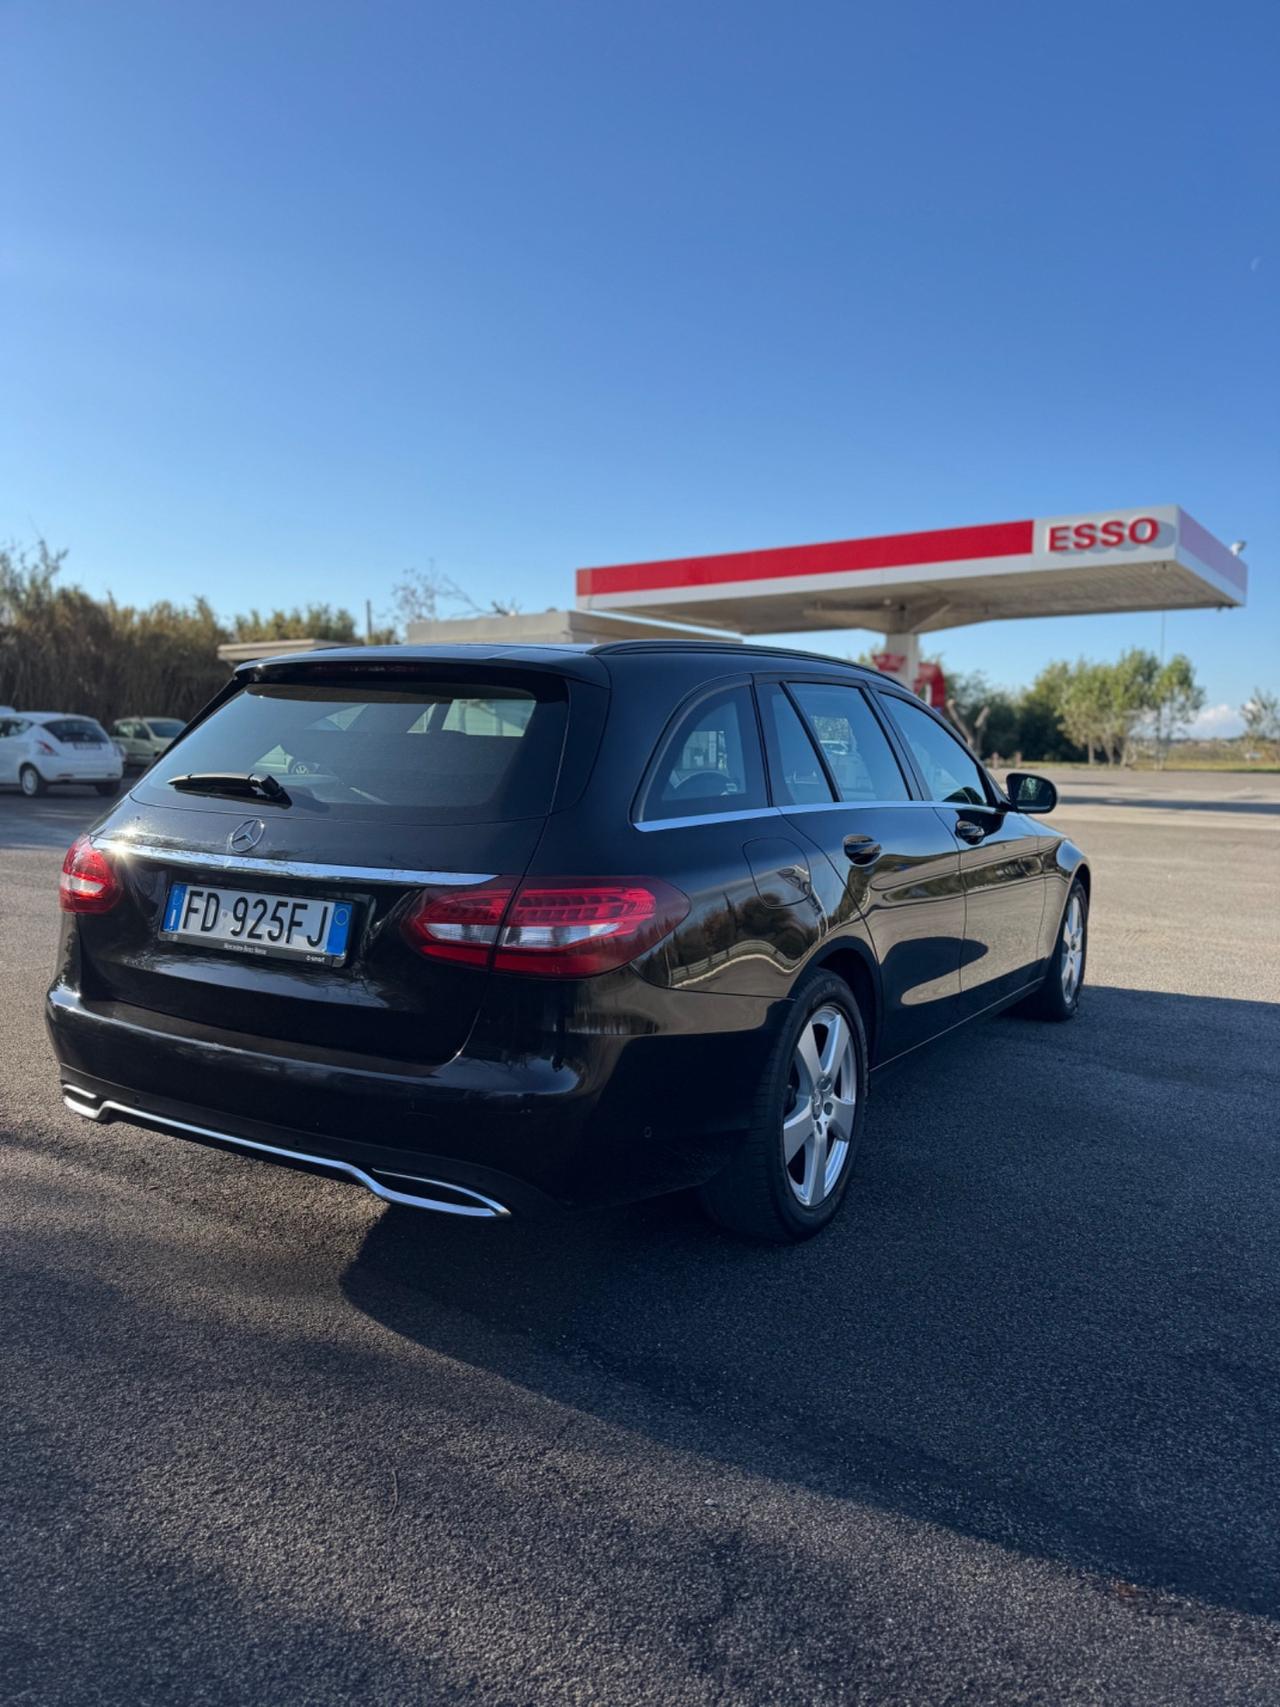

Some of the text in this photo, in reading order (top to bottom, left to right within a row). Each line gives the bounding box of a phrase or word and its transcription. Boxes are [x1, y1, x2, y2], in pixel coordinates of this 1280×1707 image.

[1048, 517, 1159, 552] ESSO
[182, 890, 328, 947] FD 925FJ
